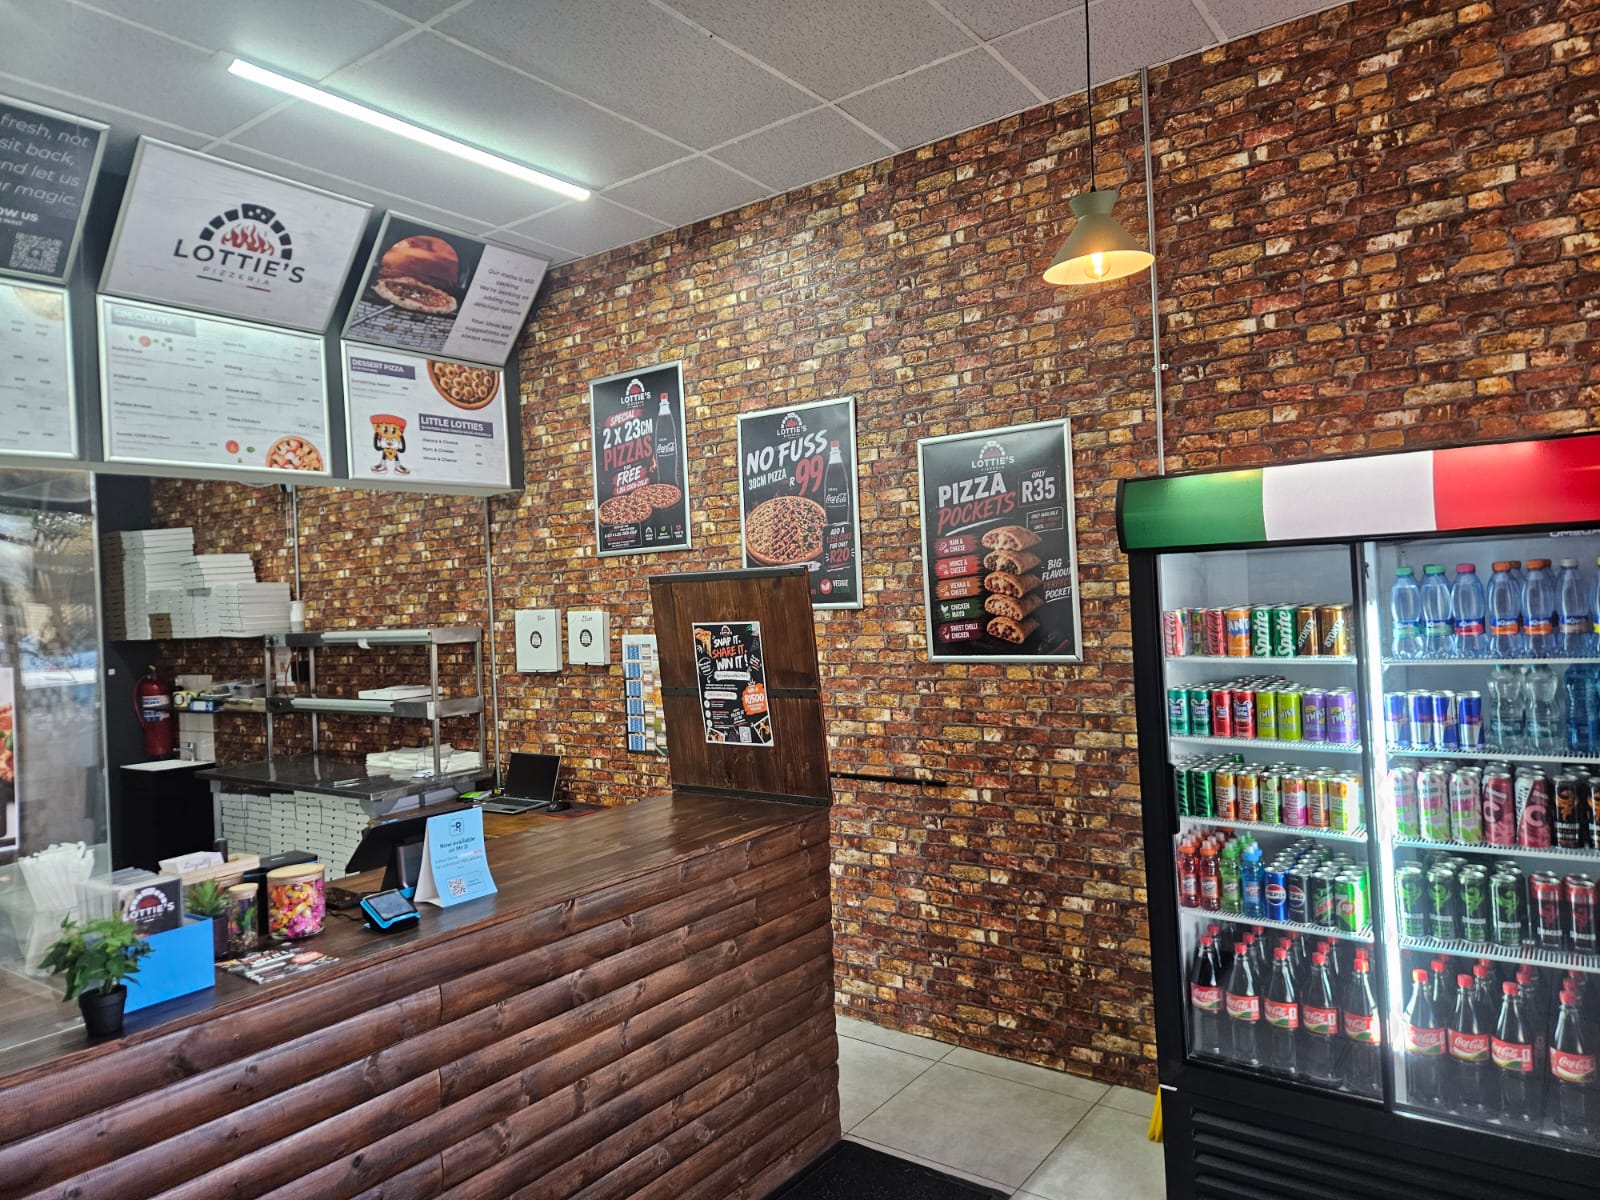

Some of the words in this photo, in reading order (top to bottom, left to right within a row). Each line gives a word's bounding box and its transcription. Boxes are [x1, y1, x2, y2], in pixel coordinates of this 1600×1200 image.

[58, 131, 90, 148] not
[26, 142, 74, 166] back,
[0, 160, 28, 175] nd
[30, 164, 56, 181] let
[59, 174, 80, 186] us
[21, 211, 39, 222] us
[174, 239, 305, 283] LOTTIE'S
[203, 265, 271, 286] PIZZERIA
[352, 358, 383, 370] DESSERT
[384, 363, 405, 373] PIZZA
[621, 391, 652, 404] LOTTIE'S
[421, 416, 449, 427] LITTLE
[451, 420, 484, 431] LOTTIES
[610, 410, 635, 426] SPECIAL
[603, 428, 611, 450] 2
[625, 418, 653, 442] 23CM
[776, 425, 808, 436] LOTTIE'S
[603, 435, 653, 472] PIZZAS
[746, 446, 774, 476] NO
[778, 429, 828, 467] FUSS
[971, 455, 1015, 468] LOTTIE'S
[617, 465, 642, 487] FREE
[748, 477, 767, 490] 30CM
[768, 468, 787, 484] PIZZA
[795, 455, 823, 496] 99
[1032, 470, 1046, 479] ONLY
[938, 472, 1007, 508] PIZZA
[1022, 476, 1056, 503] R35
[937, 491, 1017, 535] POCKETS
[830, 548, 850, 563] R20
[1048, 558, 1062, 570] BIG
[713, 637, 731, 648] SNAP
[1254, 610, 1273, 657] Sprite
[1278, 610, 1296, 657] Sprite
[712, 647, 736, 659] SHARE
[716, 658, 733, 671] WIN
[1524, 804, 1547, 827] C
[122, 901, 175, 922] LOTTIE'S
